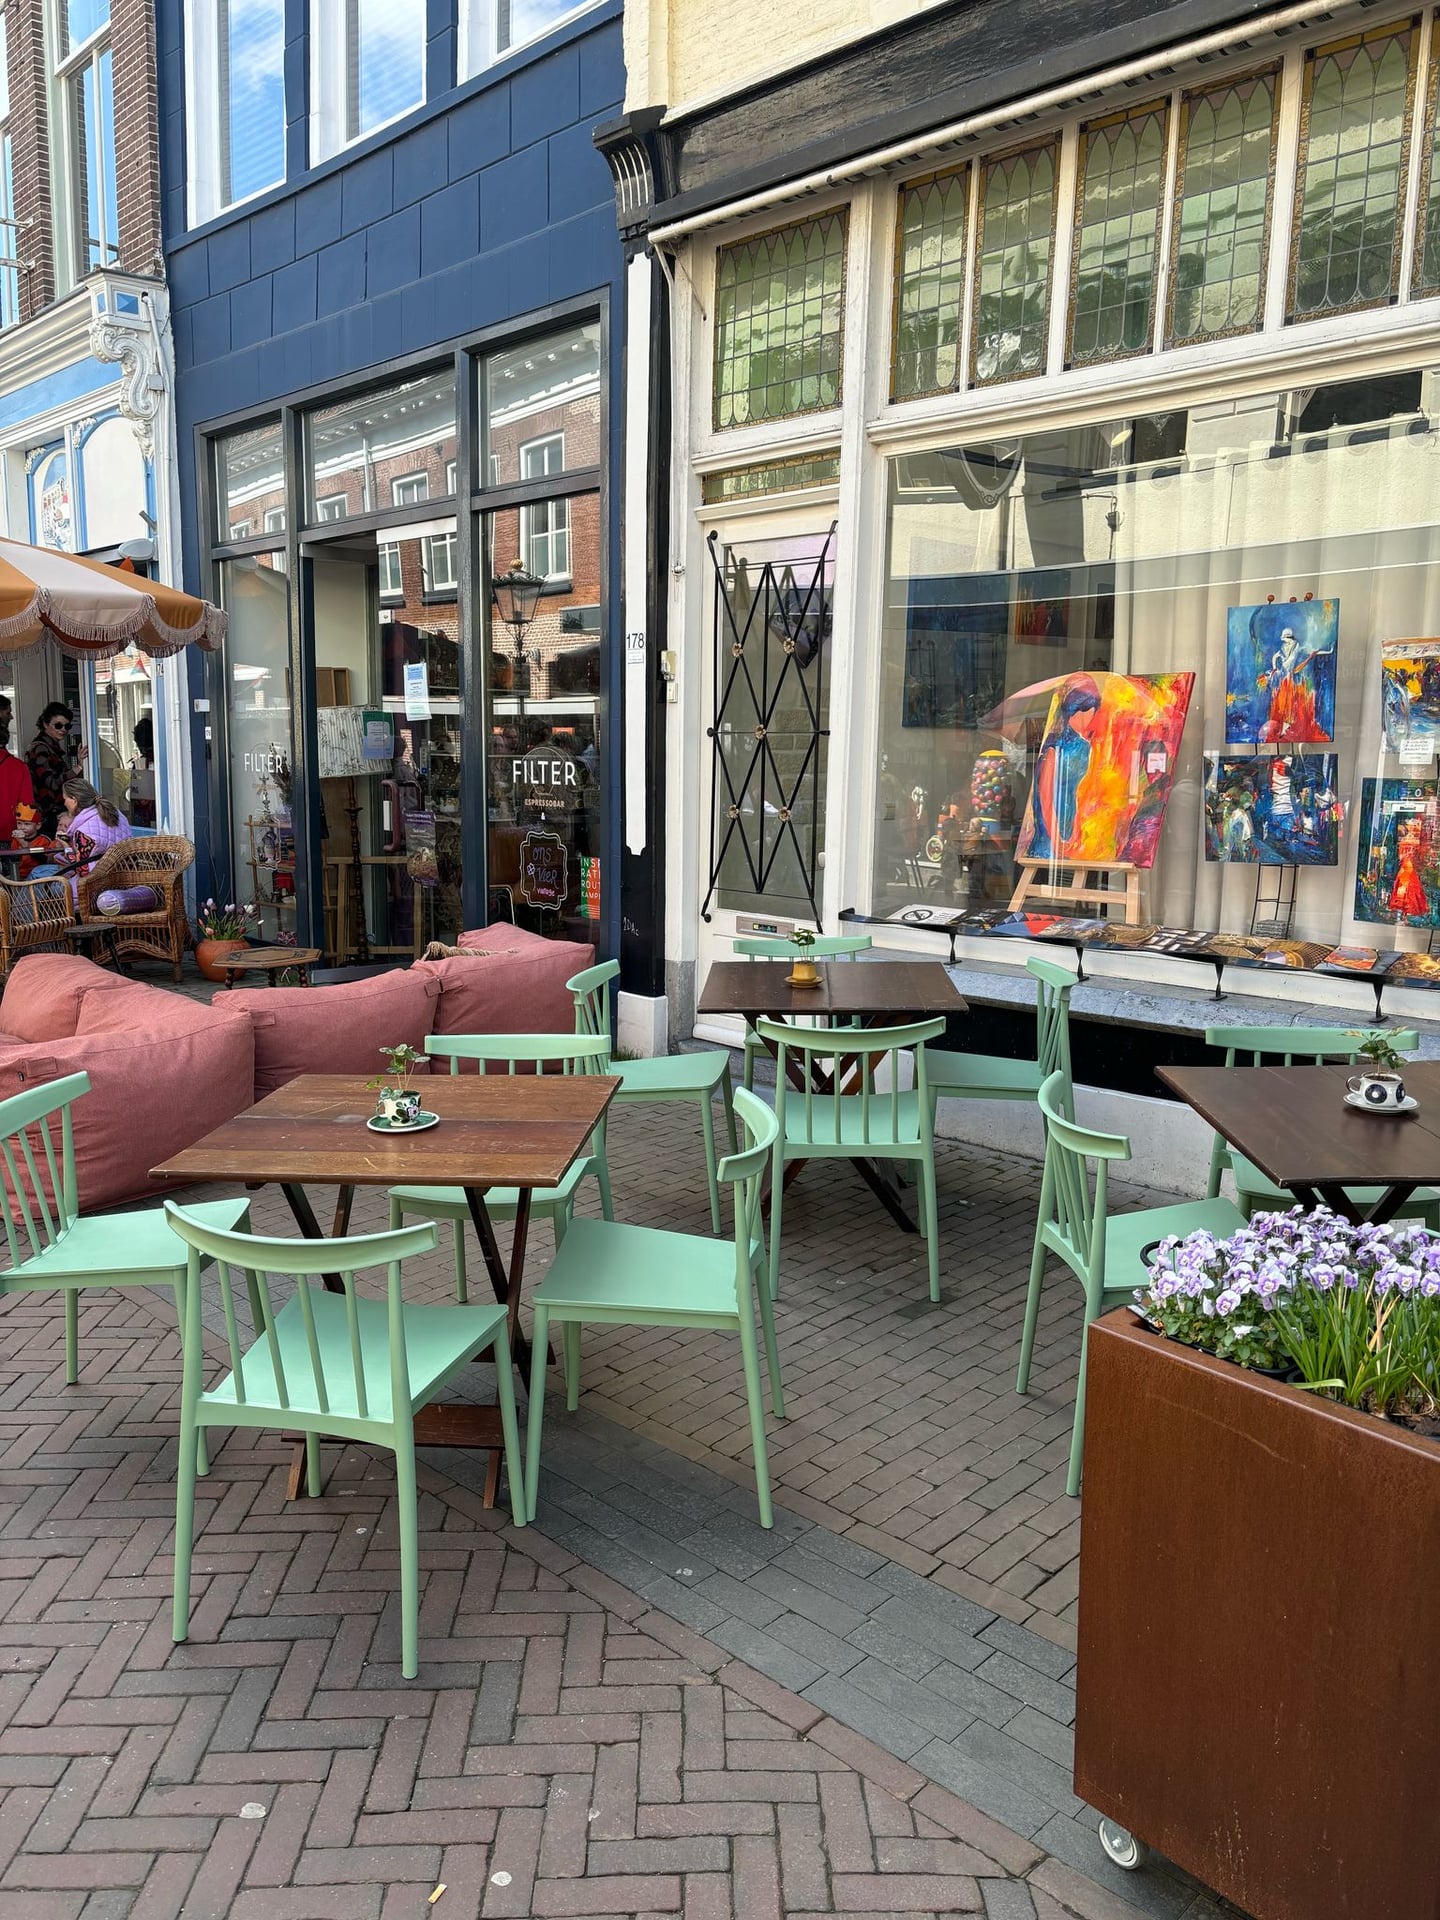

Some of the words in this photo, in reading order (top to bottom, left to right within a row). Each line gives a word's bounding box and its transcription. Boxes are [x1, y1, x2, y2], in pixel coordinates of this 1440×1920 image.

[626, 632, 645, 649] 178
[243, 752, 283, 774] FILTER
[512, 760, 577, 786] FILTER
[524, 798, 565, 808] ESPRESSOBAR
